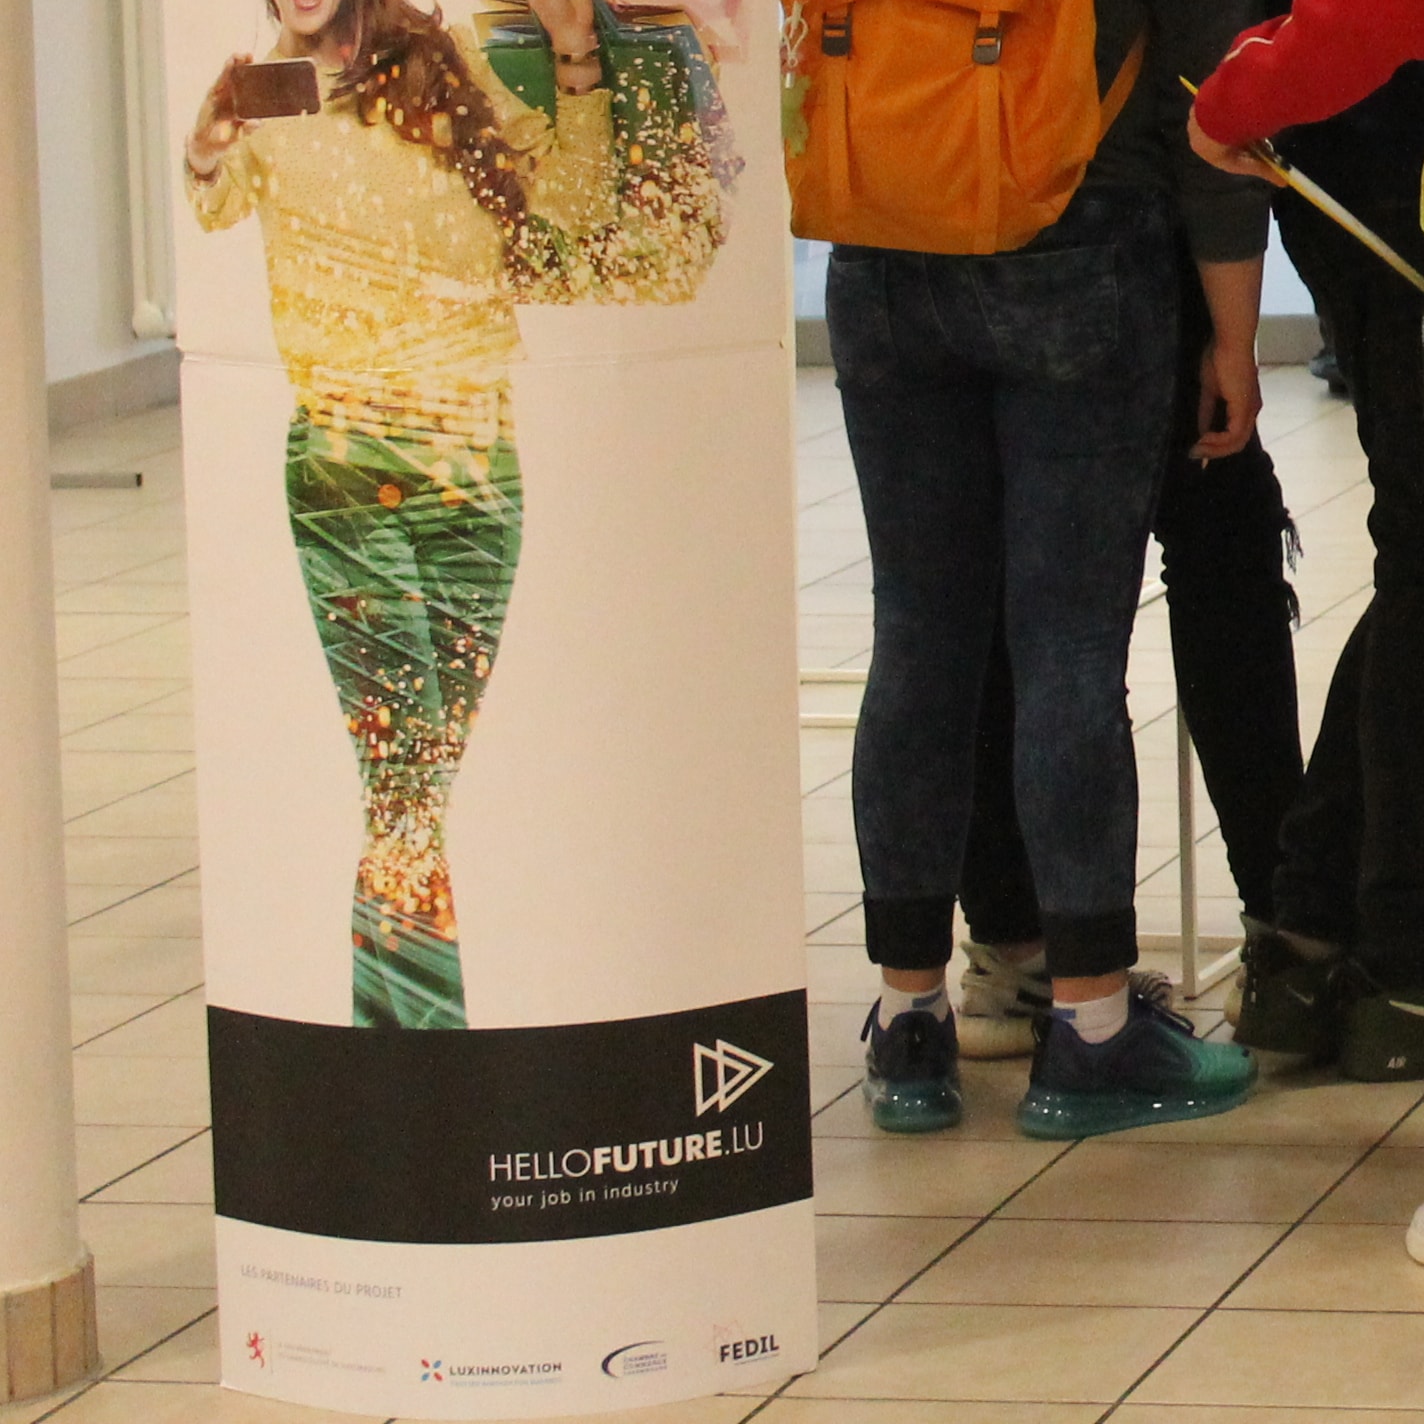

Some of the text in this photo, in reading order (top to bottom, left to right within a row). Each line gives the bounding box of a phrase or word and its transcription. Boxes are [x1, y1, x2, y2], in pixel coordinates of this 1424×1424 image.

[489, 1121, 764, 1182] HELLOFUTURE.LU
[491, 1178, 680, 1210] your job in industry
[261, 1267, 331, 1294] PARTENAIRES
[334, 1281, 351, 1296] DU
[355, 1282, 402, 1300] PROJET
[719, 1334, 780, 1363] FEDIL
[449, 1362, 562, 1377] LUXINNOVATION
